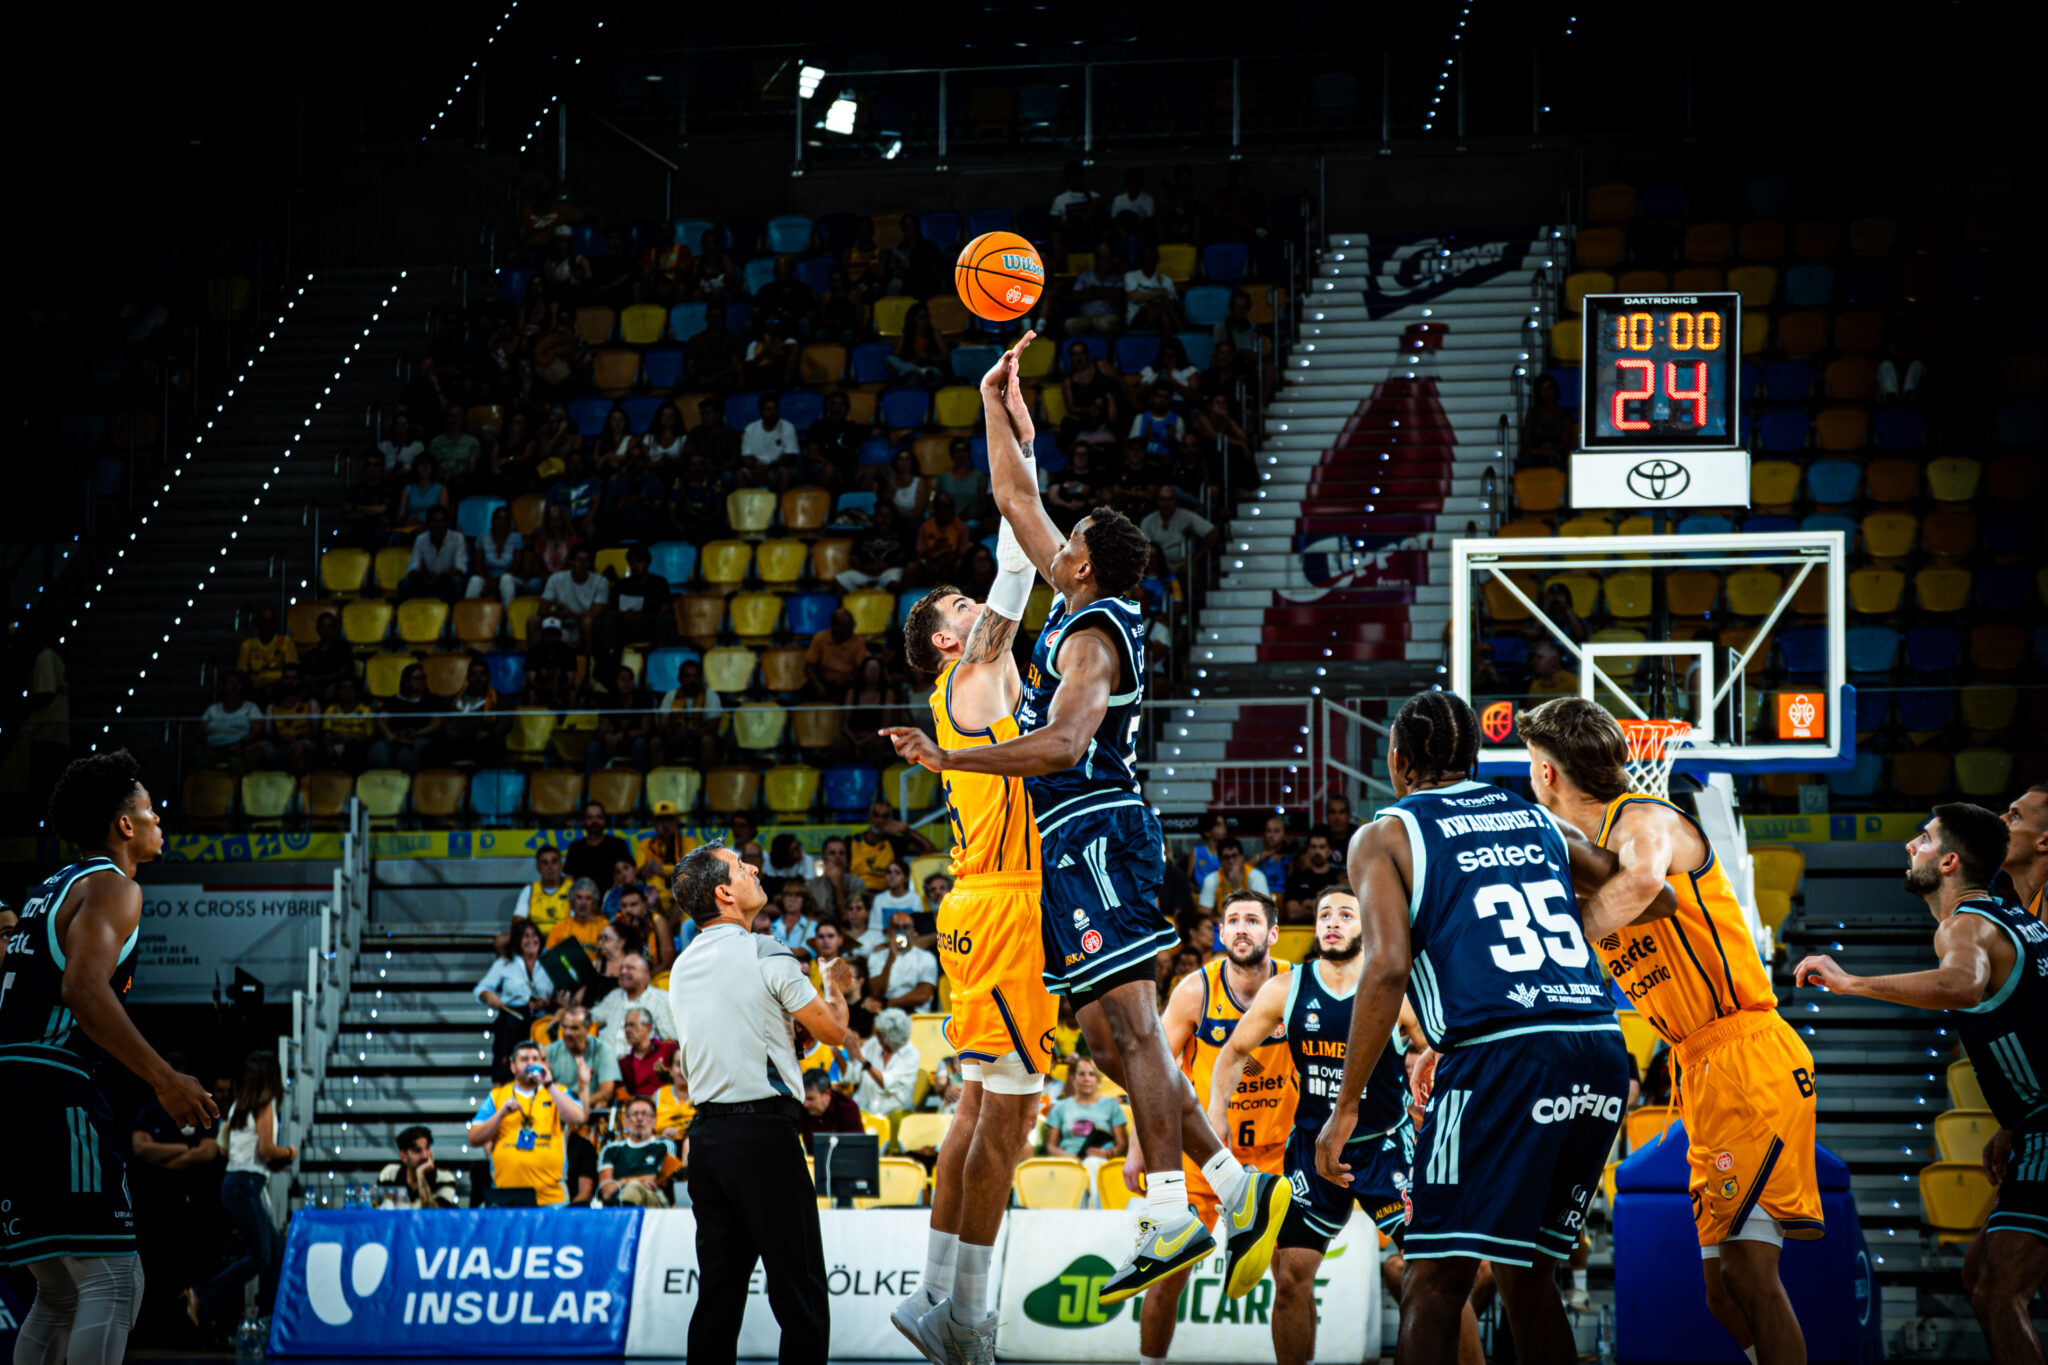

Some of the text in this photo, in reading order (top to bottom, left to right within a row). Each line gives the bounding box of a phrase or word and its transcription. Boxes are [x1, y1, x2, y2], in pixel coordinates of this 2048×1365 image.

[1002, 254, 1044, 278] Wilso
[1624, 297, 1698, 305] DAKTRONICS
[1616, 312, 1721, 351] 10:00
[1612, 358, 1708, 430] 24
[177, 900, 189, 917] X
[194, 900, 256, 917] CROSS
[1473, 879, 1590, 972] 35
[1568, 983, 1604, 996] RURAL
[1302, 1040, 1346, 1058] ALIME
[1320, 1066, 1344, 1080] OVIE
[1238, 1120, 1255, 1147] 6
[415, 1245, 584, 1280] VIAJES
[826, 1264, 920, 1296] ÖLKE
[403, 1290, 612, 1325] INSULAR
